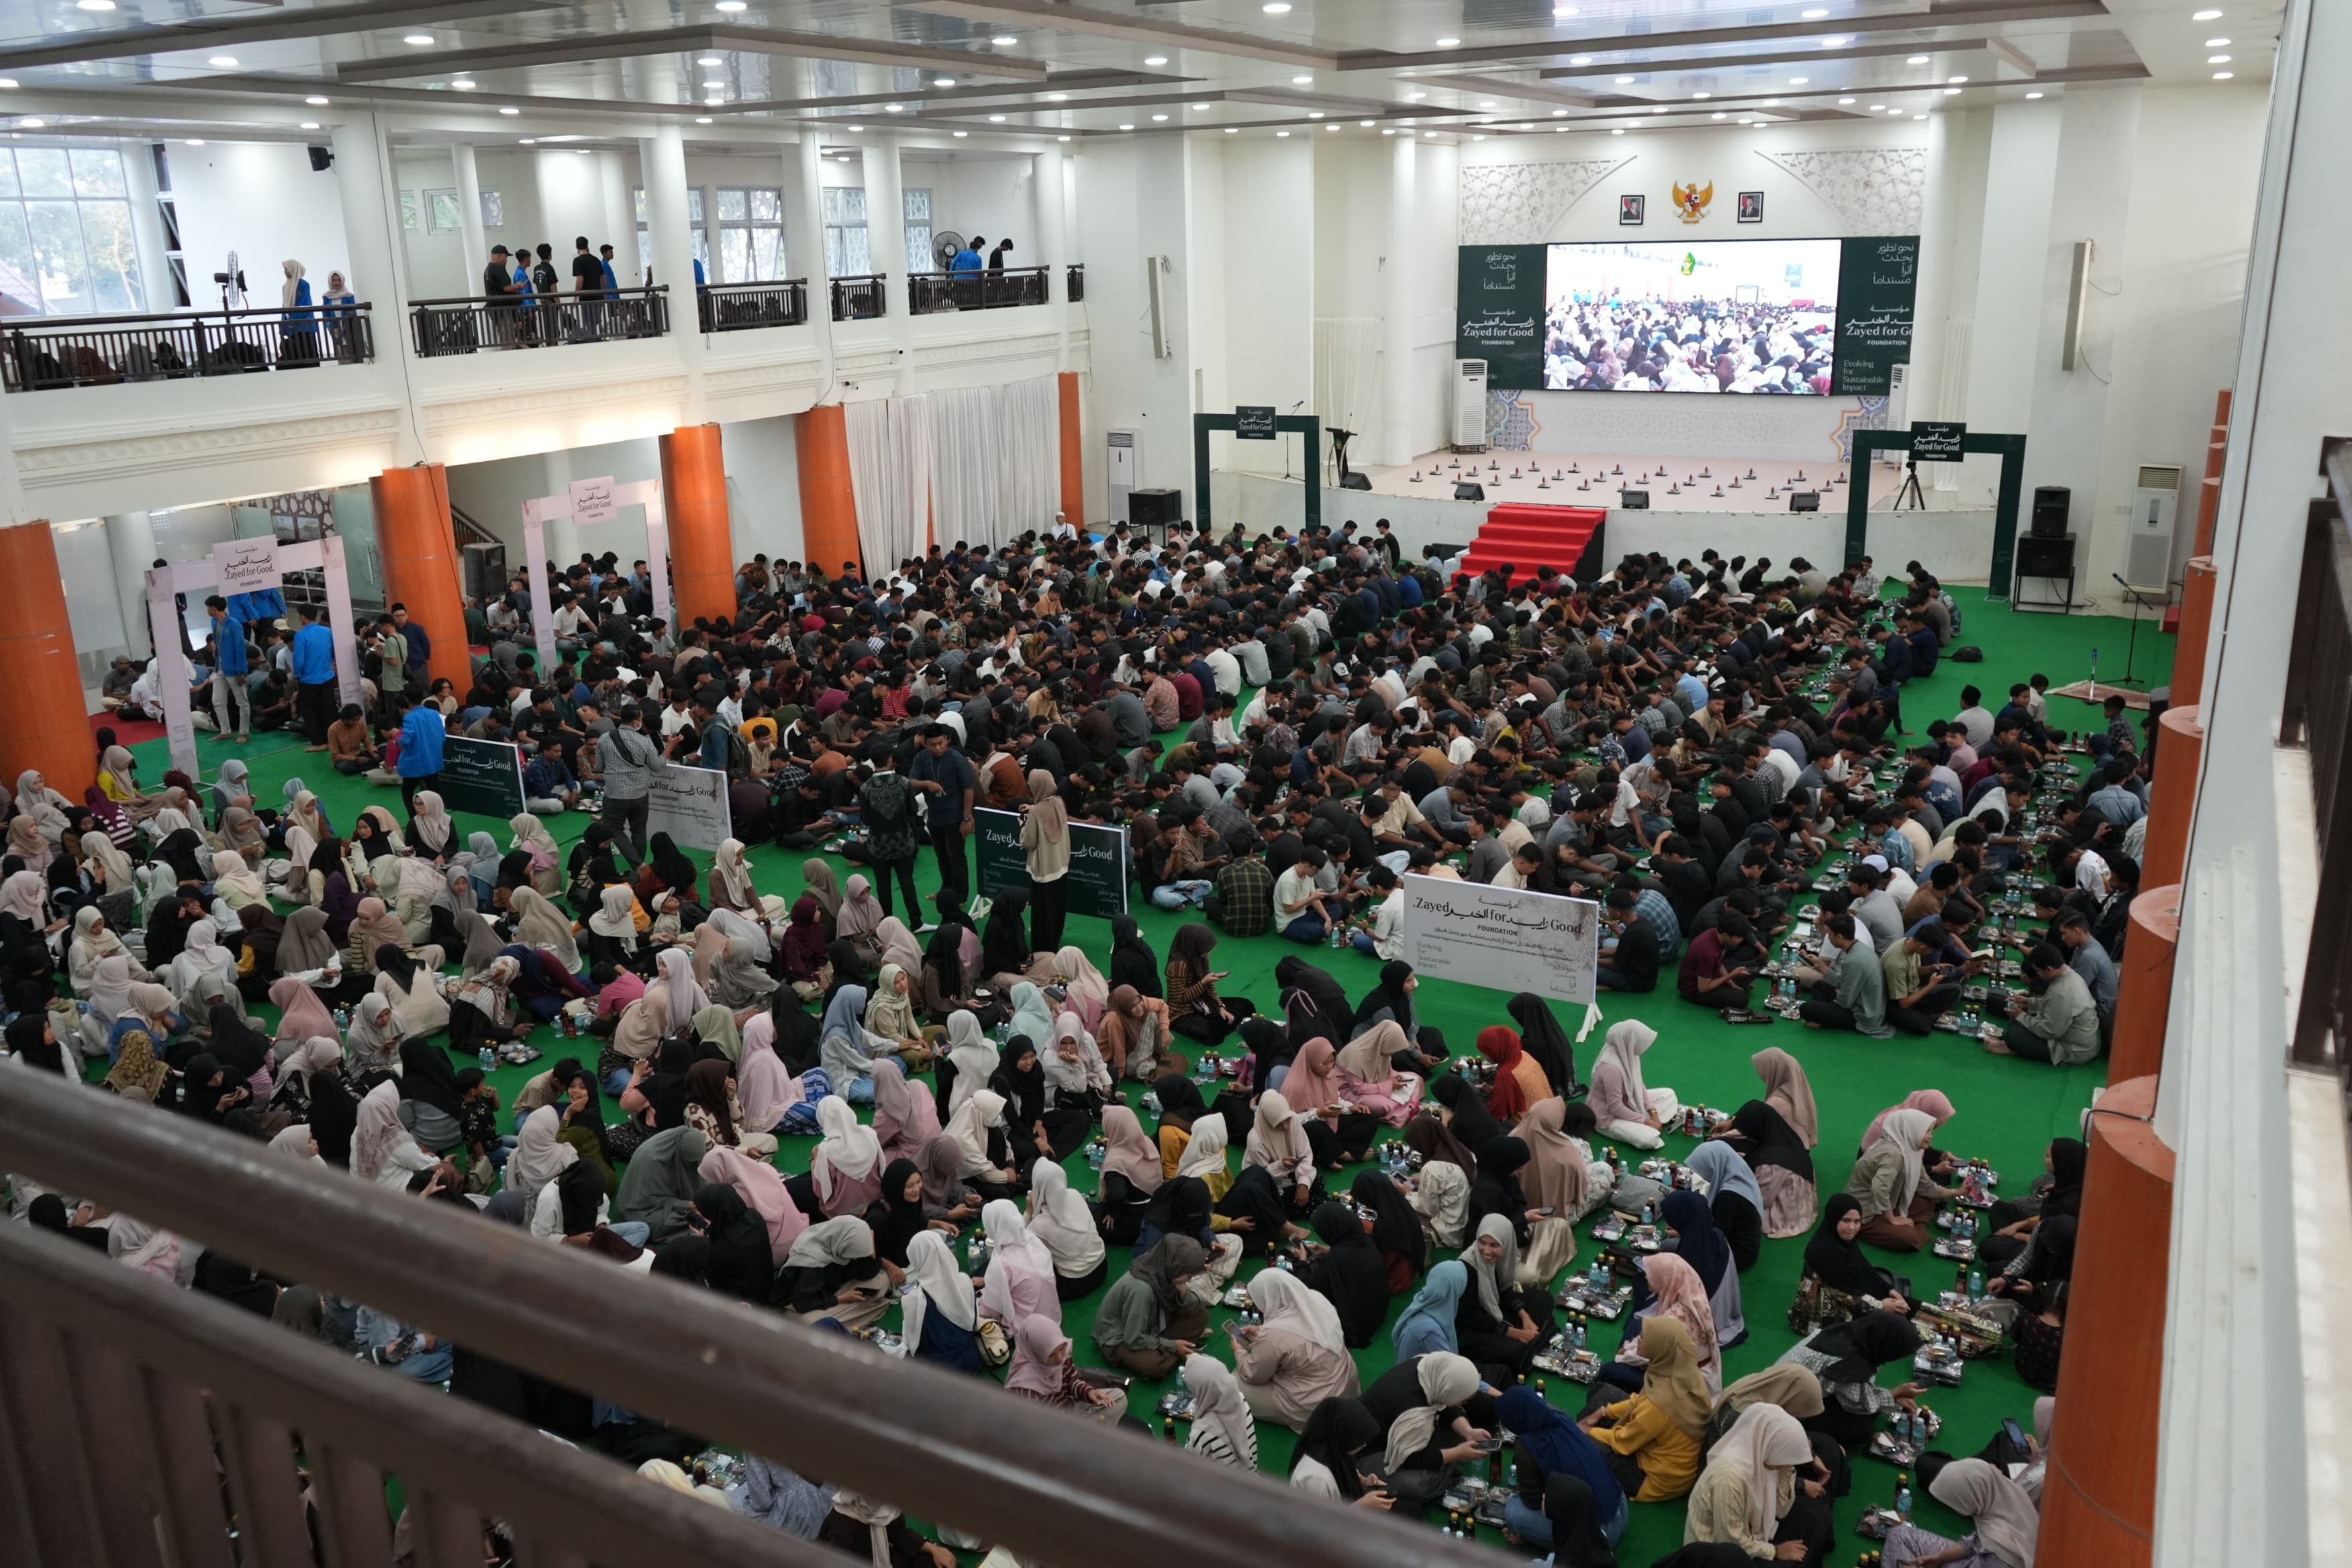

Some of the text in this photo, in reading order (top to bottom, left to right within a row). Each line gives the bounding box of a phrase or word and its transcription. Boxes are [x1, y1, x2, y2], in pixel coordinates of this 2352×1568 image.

[1463, 317, 1500, 328] الخير
[1464, 328, 1491, 338] Zayed
[1493, 328, 1508, 336] for
[1847, 326, 1879, 337] Zayed
[1883, 326, 1899, 336] for
[1844, 360, 1874, 369] Evolving
[1843, 383, 1866, 392] Impact
[1914, 442, 1932, 451] Zayed
[1934, 442, 1943, 450] for
[246, 567, 256, 576] for
[462, 754, 511, 771] for Good
[658, 782, 669, 790] for
[986, 829, 1113, 860] Zayed Good
[1478, 895, 1518, 909] مؤسسة
[1444, 908, 1549, 930] زايد الخير
[1490, 909, 1507, 922] for
[1477, 924, 1518, 936] FOUNDATION
